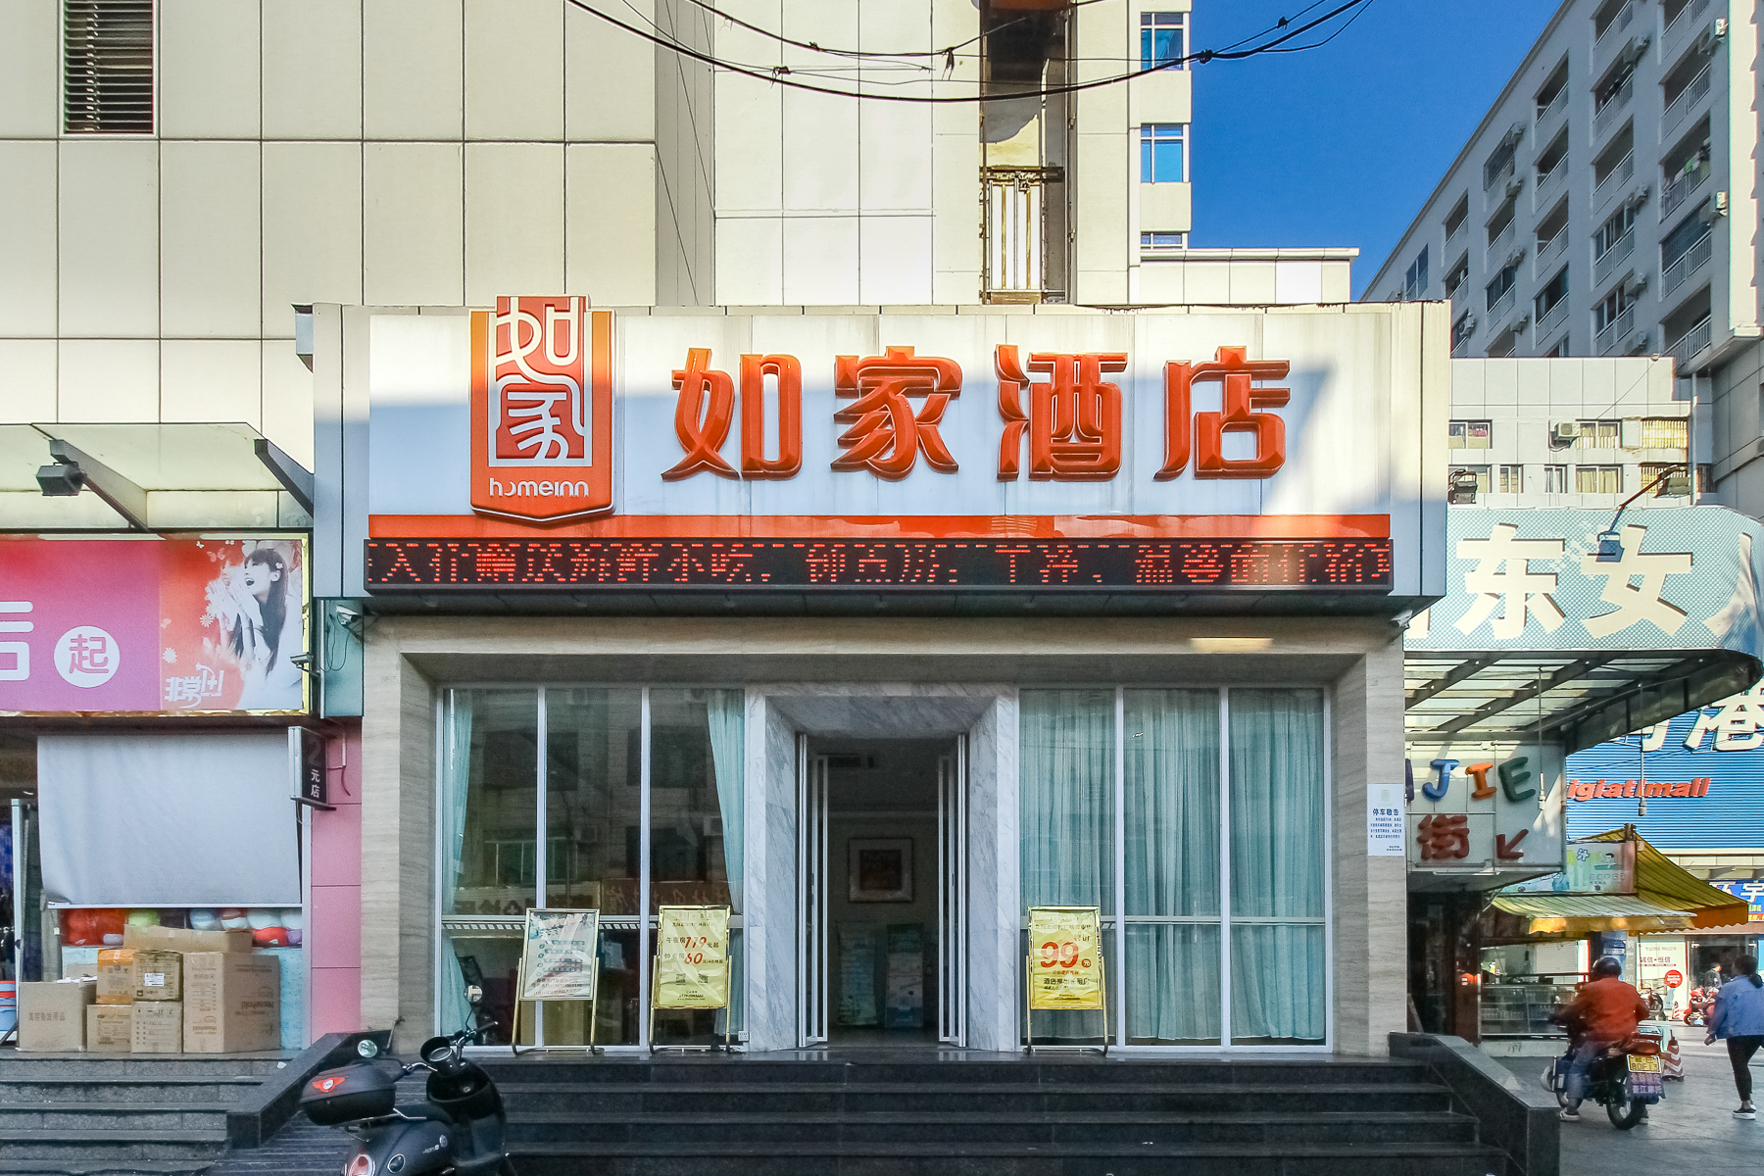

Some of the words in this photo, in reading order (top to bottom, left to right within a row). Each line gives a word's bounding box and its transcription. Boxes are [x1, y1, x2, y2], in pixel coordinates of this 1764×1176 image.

[661, 344, 1291, 482] 如家酒店
[69, 633, 110, 674] 起
[1405, 756, 1537, 803] JIE
[1416, 813, 1471, 861] 街
[1040, 941, 1079, 968] 99
